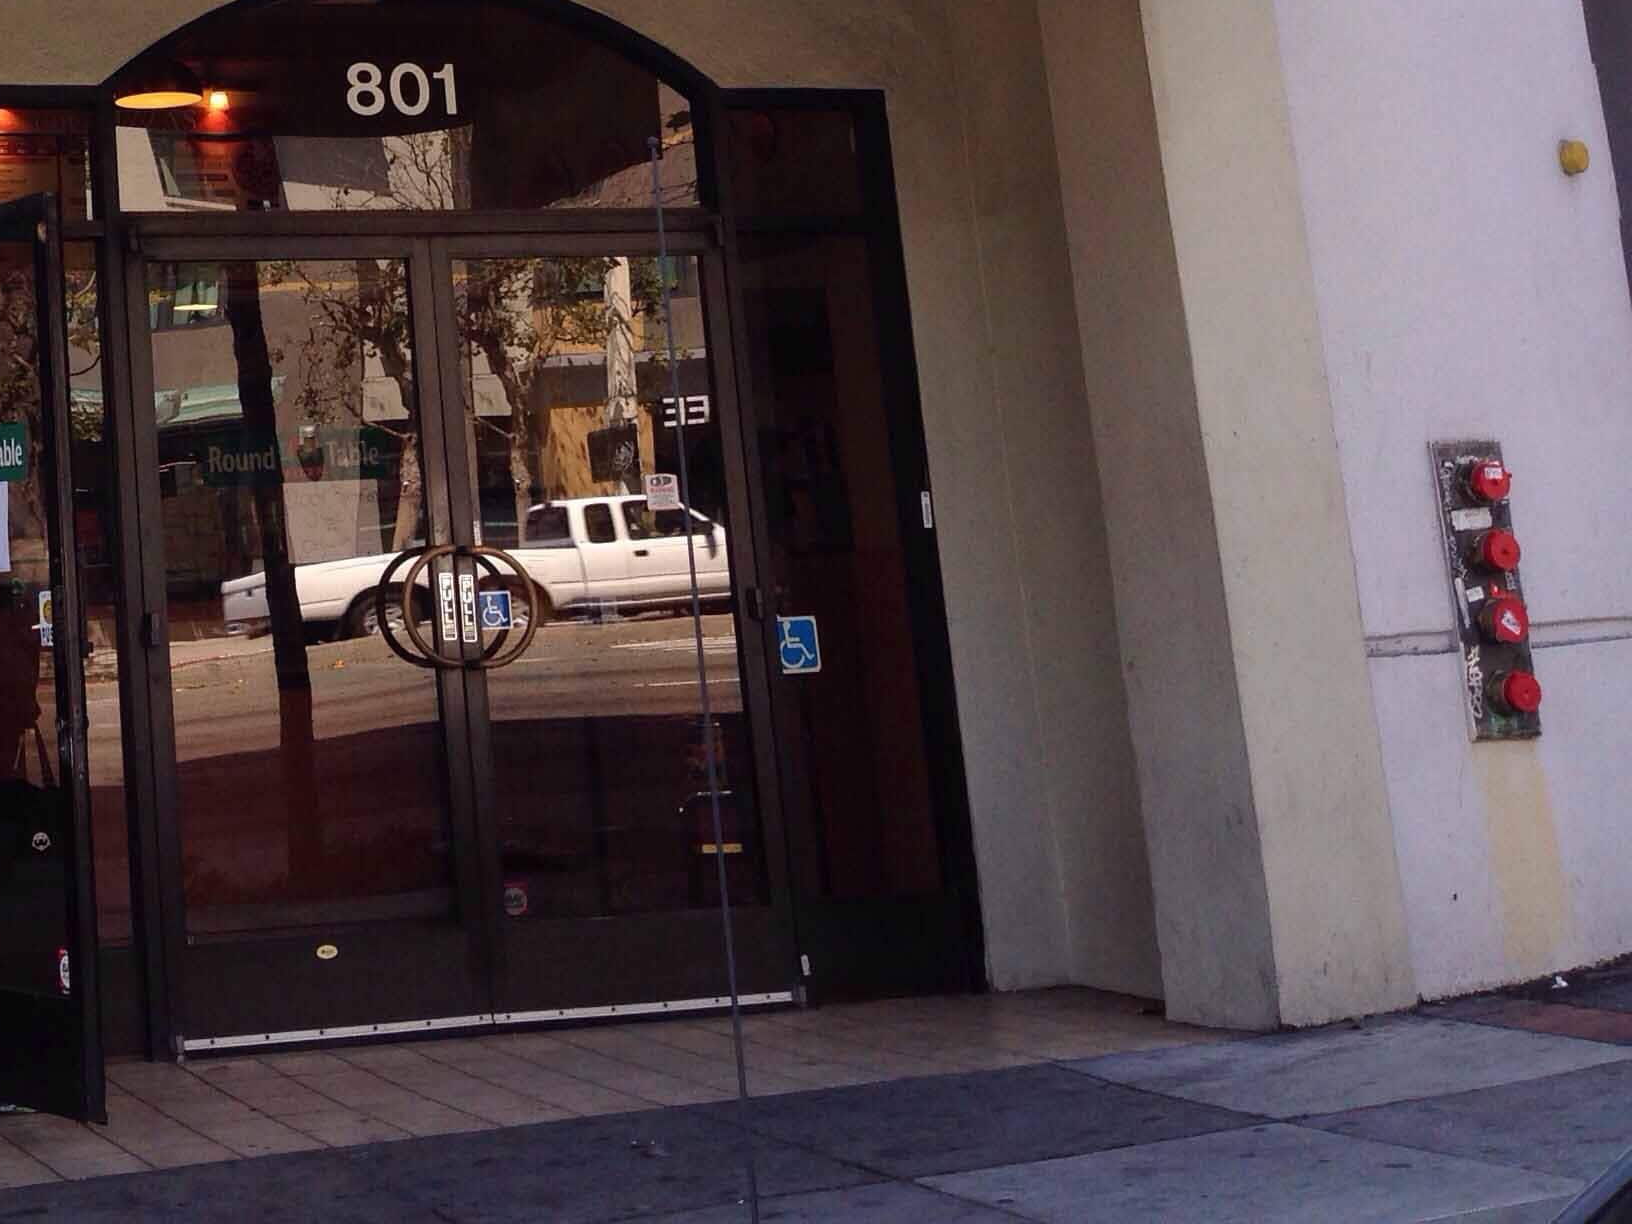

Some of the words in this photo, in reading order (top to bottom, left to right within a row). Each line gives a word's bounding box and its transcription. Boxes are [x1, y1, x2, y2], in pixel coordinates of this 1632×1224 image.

[346, 61, 458, 116] 801
[208, 445, 276, 473] Round
[325, 440, 380, 467] Table
